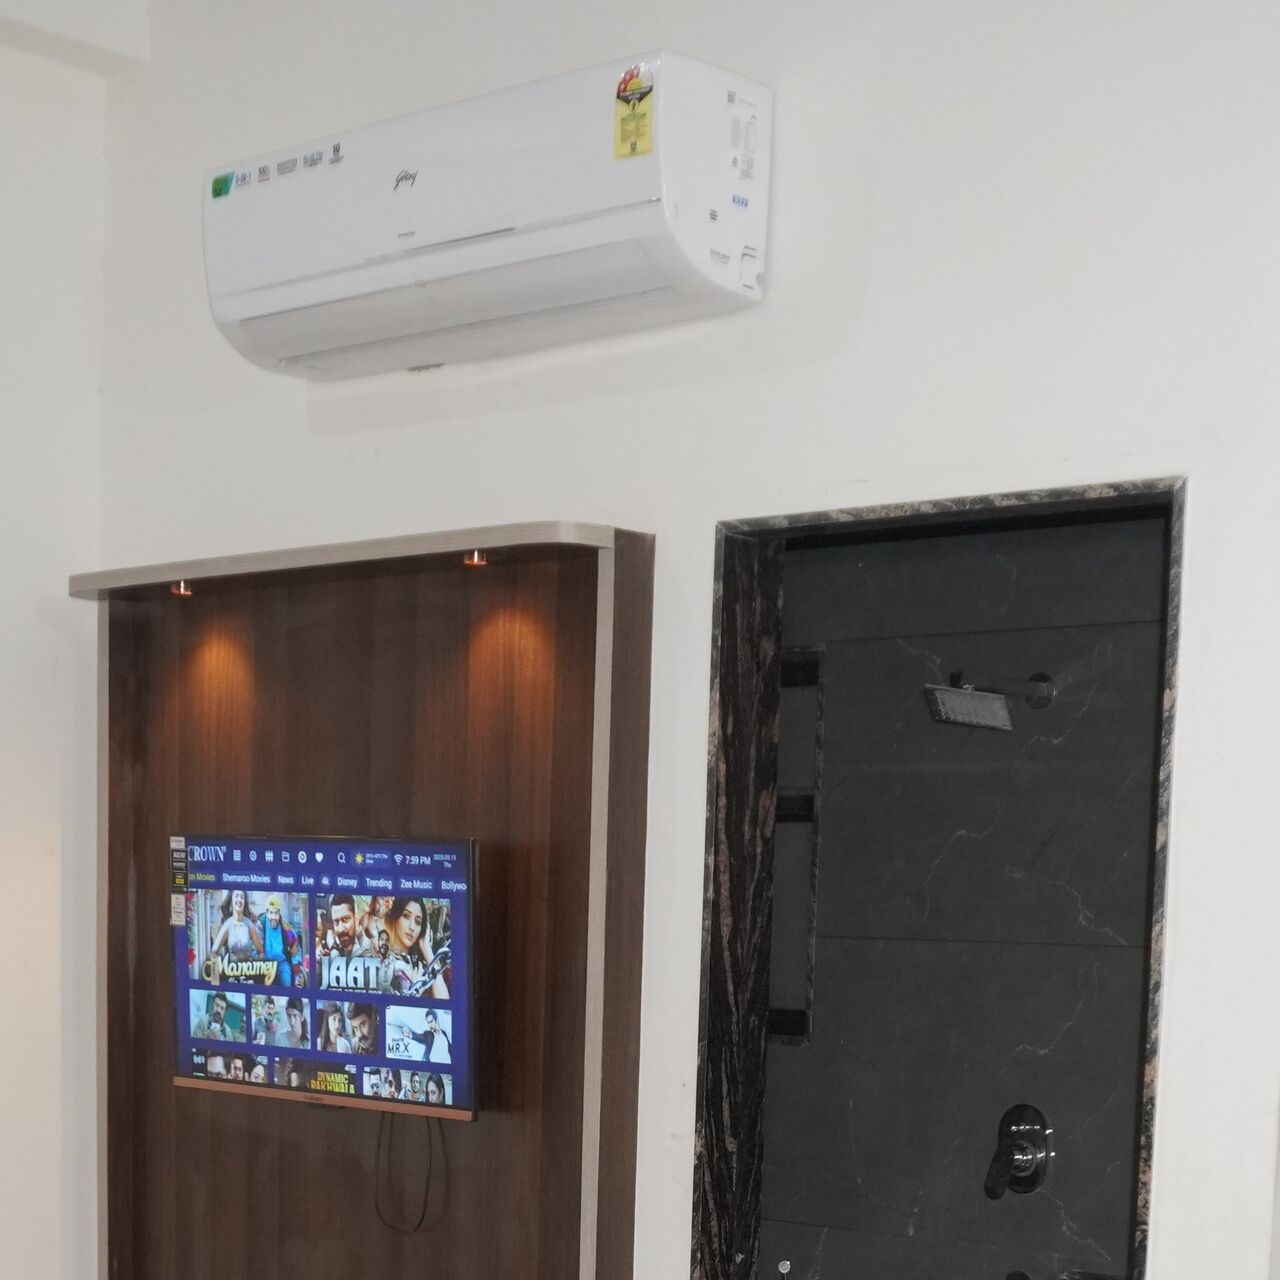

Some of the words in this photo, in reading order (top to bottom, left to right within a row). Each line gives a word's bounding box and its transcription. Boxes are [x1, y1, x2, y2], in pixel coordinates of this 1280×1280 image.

[187, 846, 224, 862] CROWN
[406, 855, 418, 865] 7:59
[420, 856, 431, 866] PM
[196, 873, 215, 881] Movies
[222, 873, 249, 882] Shemaroo
[250, 874, 270, 883] Movies
[278, 875, 294, 884] News
[302, 876, 314, 885] Live
[337, 877, 358, 888] Disney
[366, 878, 392, 889] Trending
[401, 879, 412, 888] Zee
[413, 880, 433, 890] Music
[319, 956, 382, 991] JAAT
[317, 1071, 349, 1084] DYNAMIC
